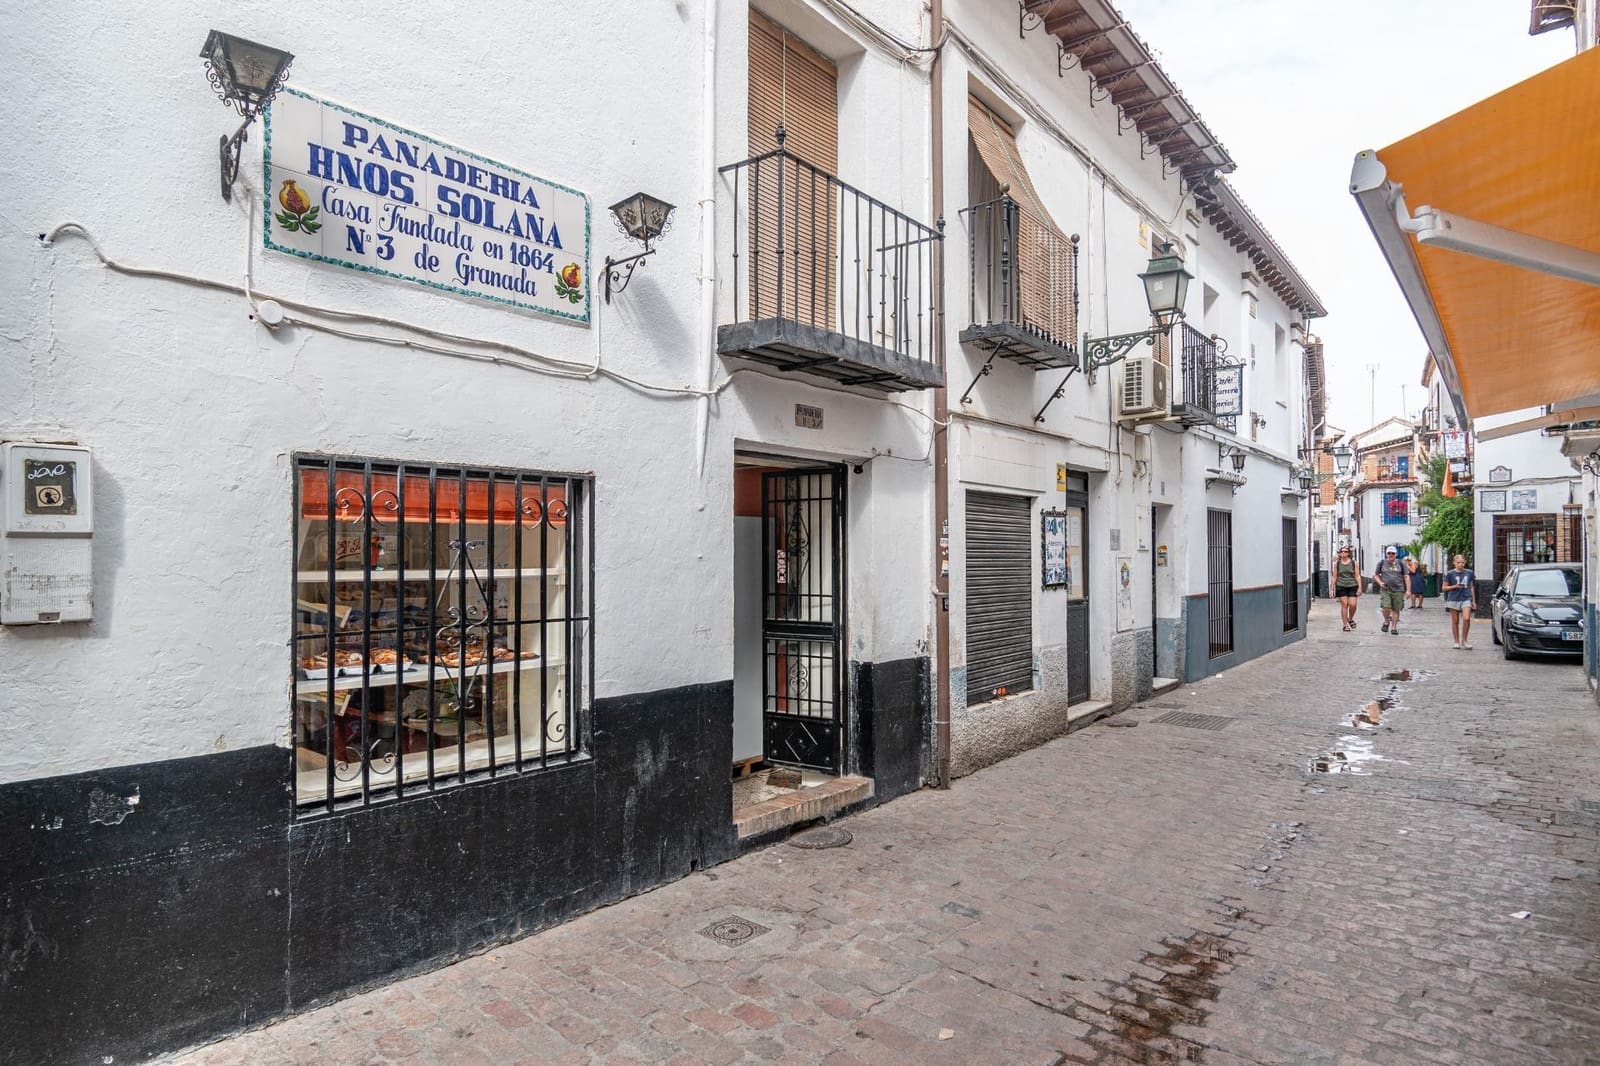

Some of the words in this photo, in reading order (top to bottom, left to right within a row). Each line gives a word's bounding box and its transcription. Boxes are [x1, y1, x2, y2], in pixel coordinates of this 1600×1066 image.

[307, 142, 419, 207] HNOS.
[437, 184, 563, 250] SOLANA
[342, 121, 540, 210] PANADERIA
[322, 185, 372, 224] Casa
[378, 203, 474, 252] Fundada
[483, 238, 503, 261] en
[510, 241, 554, 274] 1864
[376, 233, 395, 261] 3
[414, 244, 439, 273] de
[452, 252, 537, 297] Granada
[1455, 575, 1468, 589] 14
